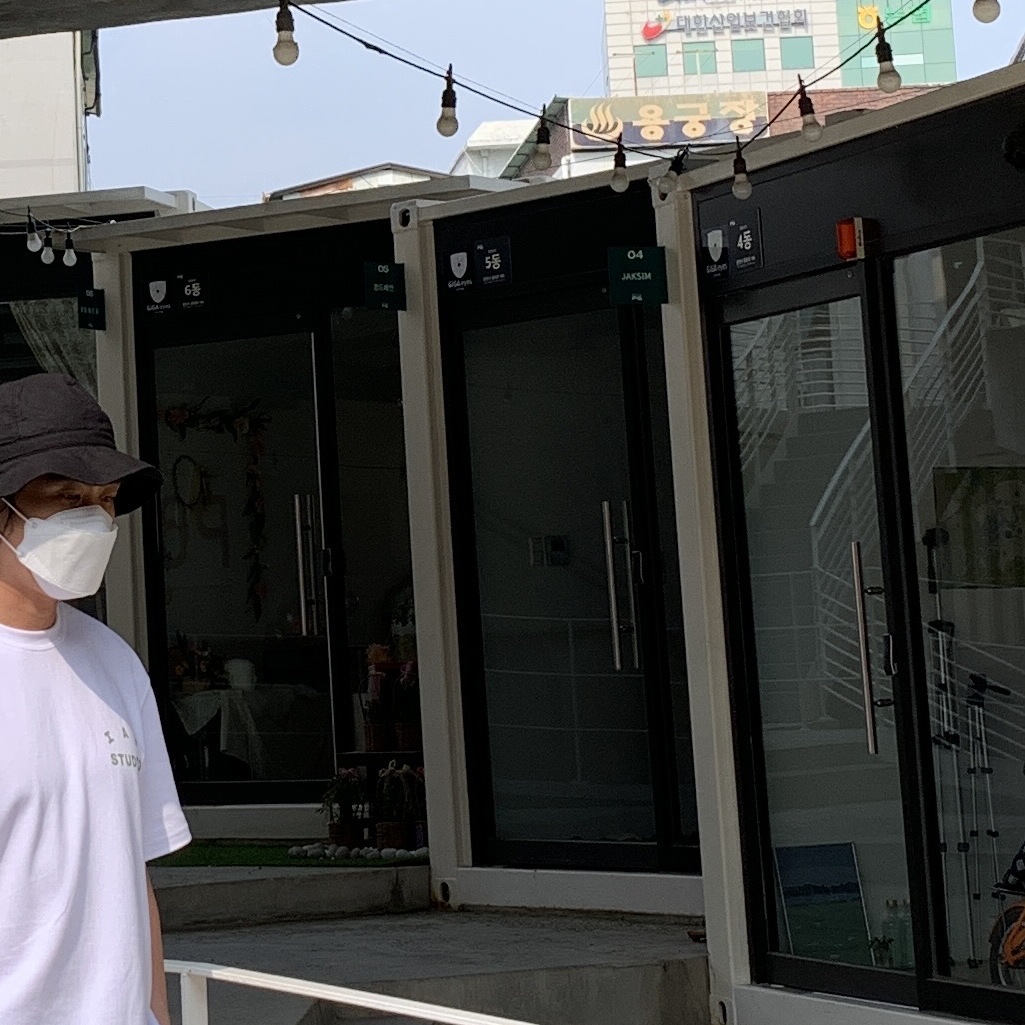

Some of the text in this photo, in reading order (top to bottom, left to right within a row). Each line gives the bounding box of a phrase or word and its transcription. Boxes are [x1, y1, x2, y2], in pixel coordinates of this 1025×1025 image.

[676, 9, 808, 37] 대한산업보건협회
[632, 97, 760, 141] 용궁장
[736, 229, 753, 250] 4동
[485, 253, 502, 270] 5동
[627, 249, 644, 260] 04
[621, 271, 652, 281] JAKSIM
[184, 282, 201, 297] 6동
